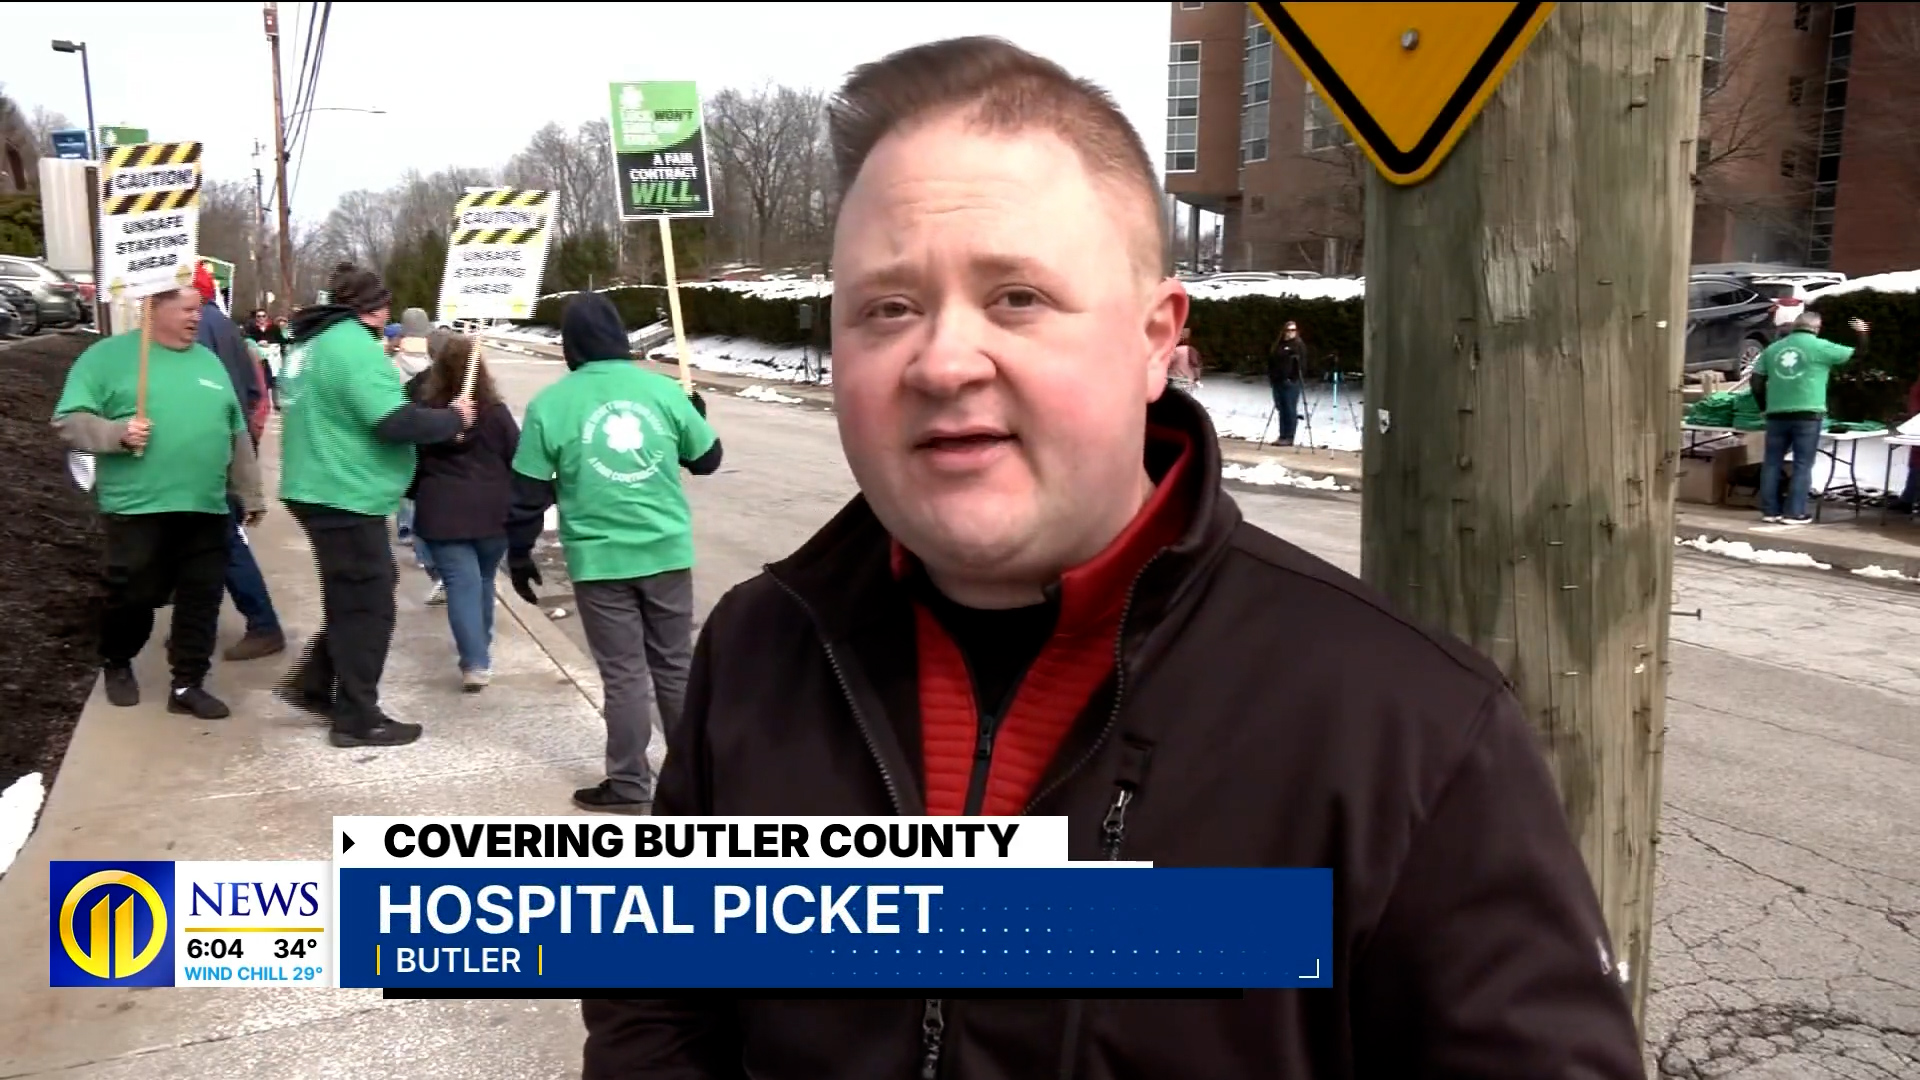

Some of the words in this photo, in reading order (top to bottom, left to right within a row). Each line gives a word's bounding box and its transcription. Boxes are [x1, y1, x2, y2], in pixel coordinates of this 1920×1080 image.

[653, 153, 663, 166] A
[664, 152, 694, 166] FAIR
[629, 167, 698, 181] CONTRACT
[631, 179, 701, 206] WILL.
[122, 214, 184, 235] UNSAFE
[115, 233, 190, 255] STAFFING
[126, 253, 177, 273] AHEAD
[462, 250, 522, 262] UNSAFE
[453, 267, 526, 279] STAFFING
[460, 283, 513, 295] AHEAD
